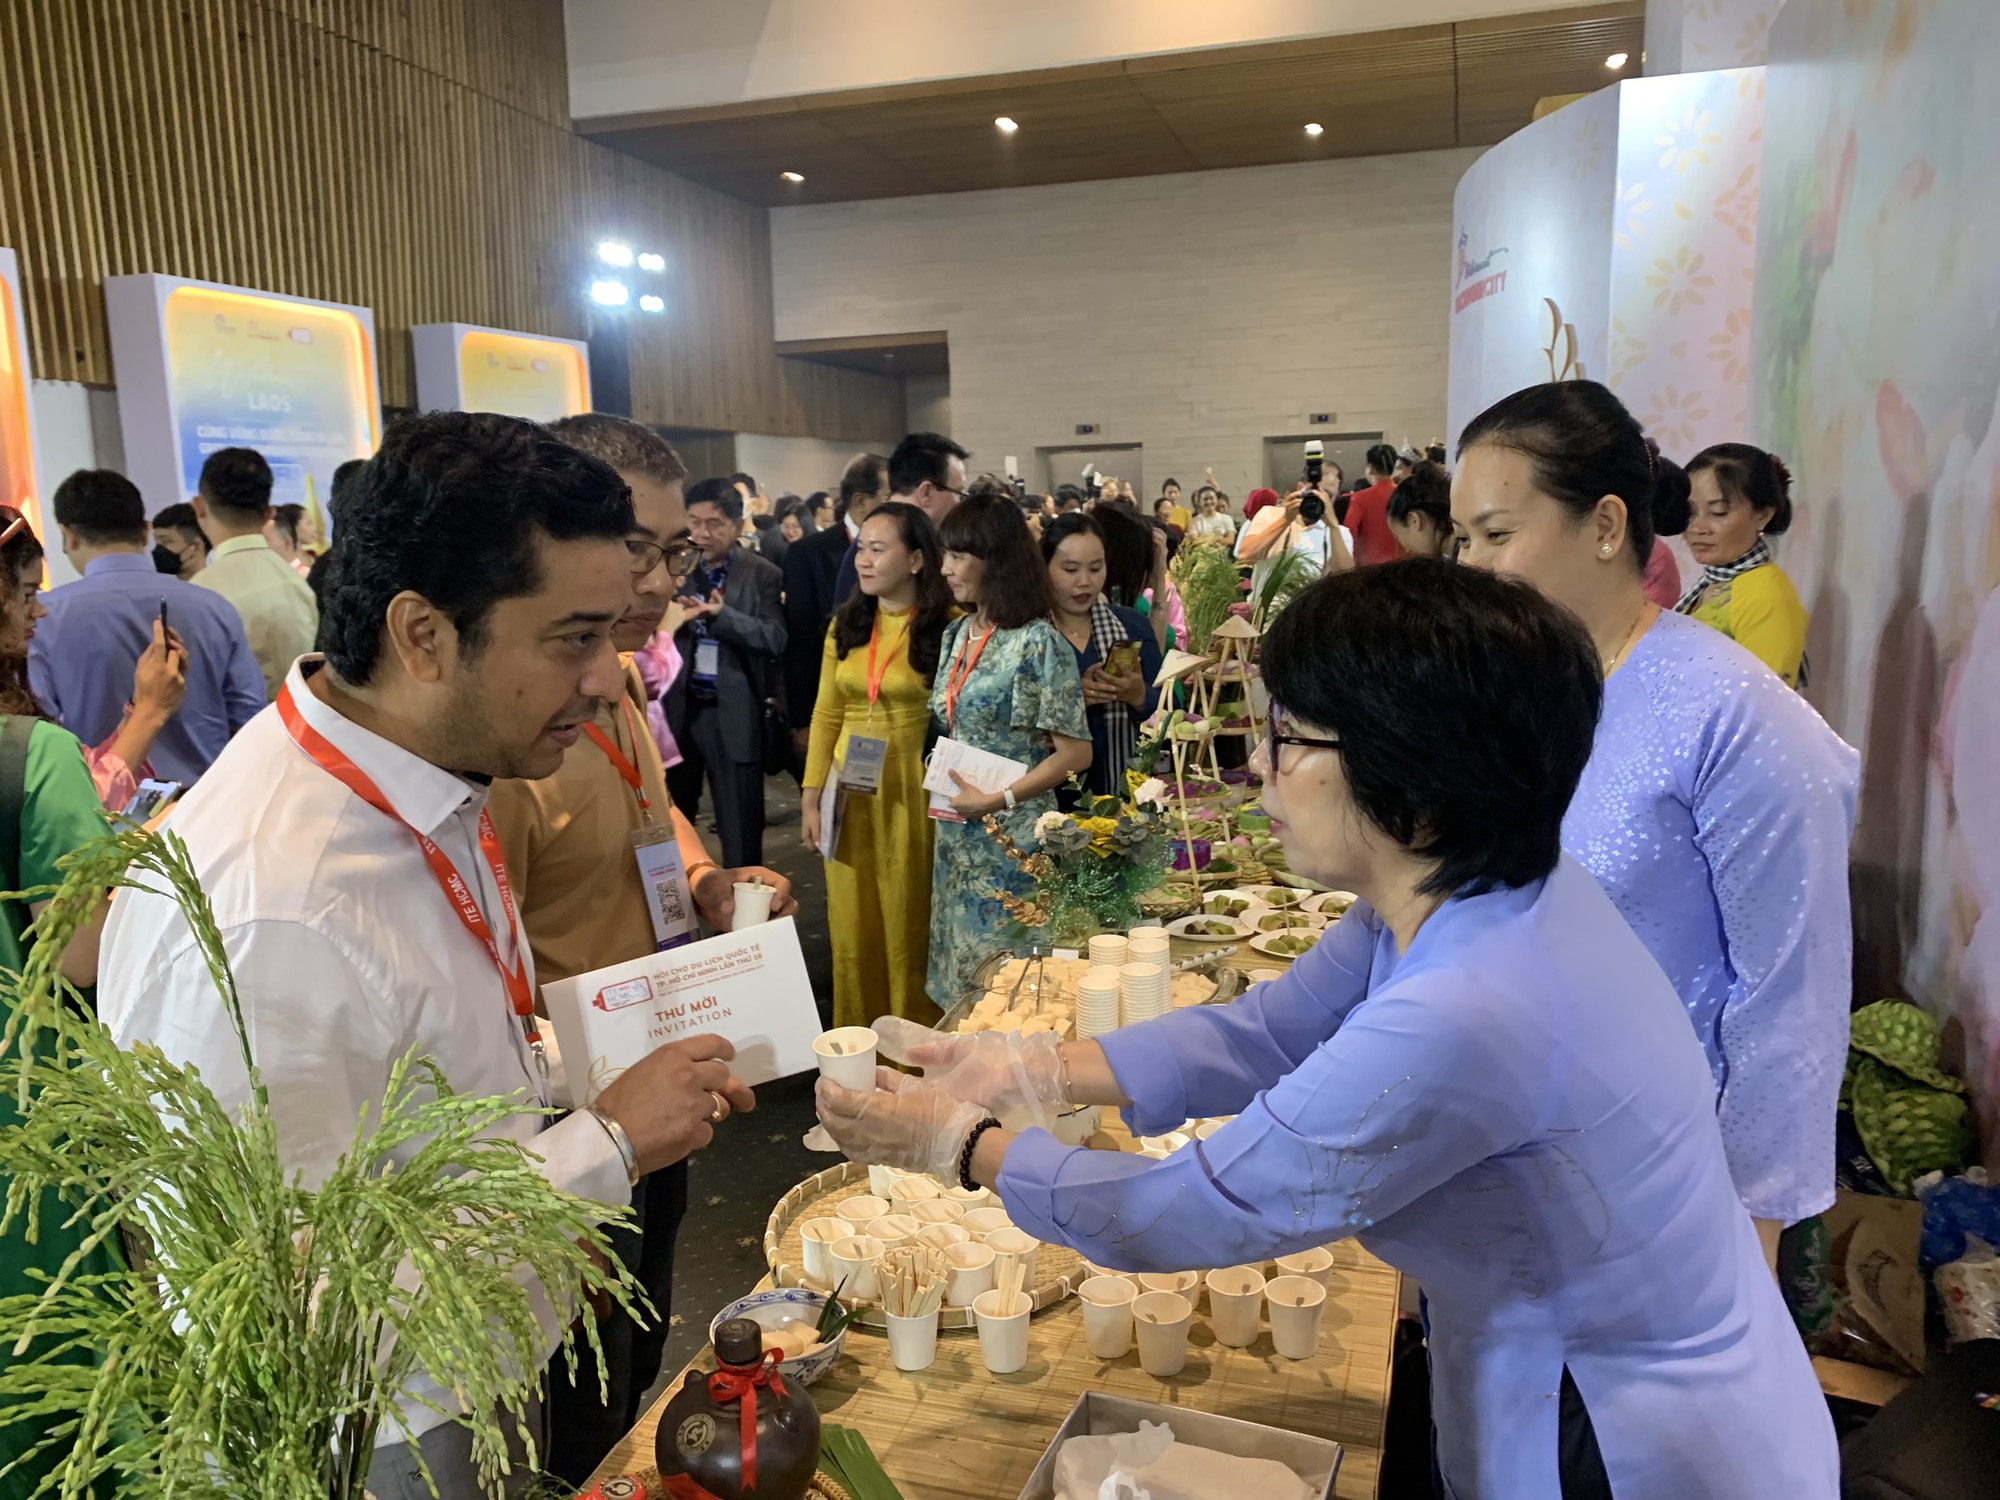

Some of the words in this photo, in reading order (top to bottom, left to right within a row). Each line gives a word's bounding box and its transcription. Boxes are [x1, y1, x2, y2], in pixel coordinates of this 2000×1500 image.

[495, 863, 507, 882] ITE
[447, 873, 472, 906] HCMC
[463, 905, 481, 923] ITE
[697, 967, 718, 977] MINH
[654, 1003, 686, 1022] THƯ
[690, 996, 718, 1013] MỜI
[648, 1007, 732, 1038] INVITATION
